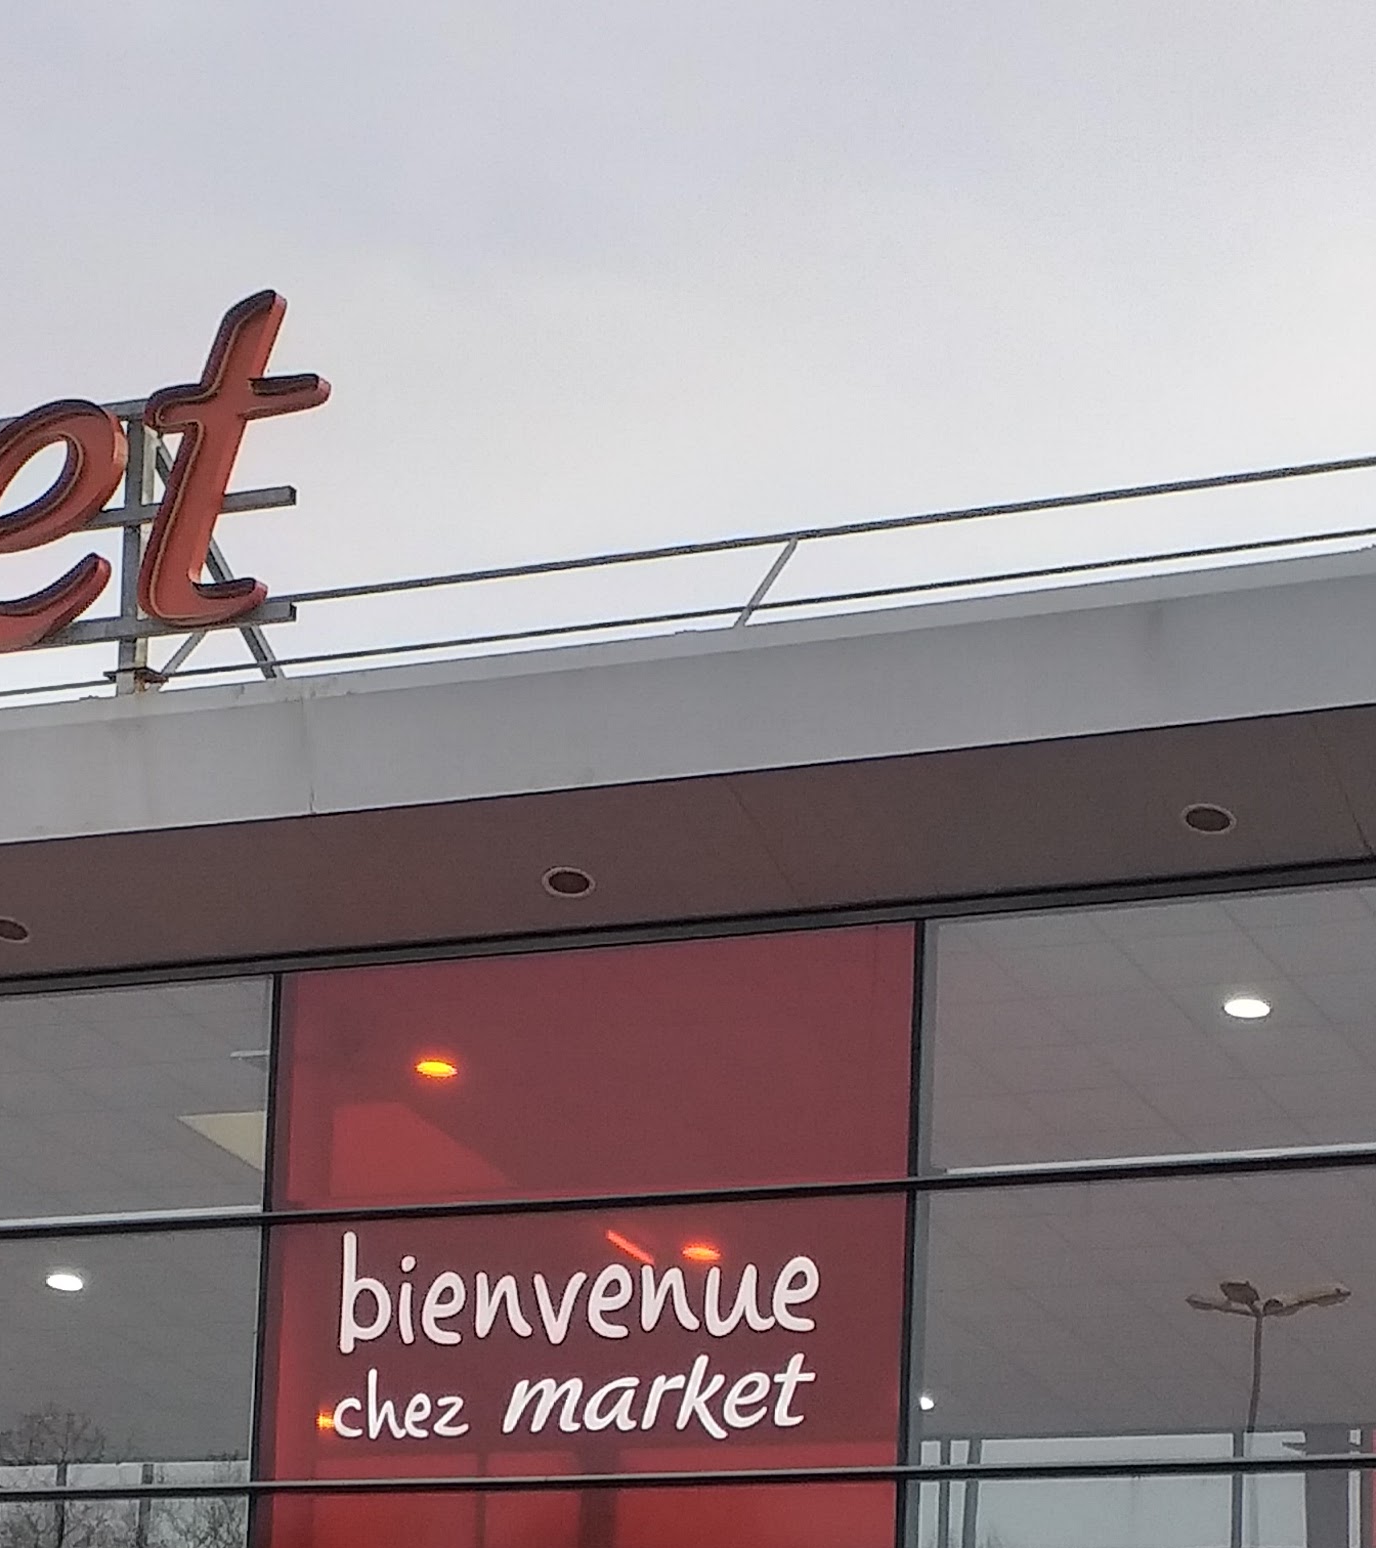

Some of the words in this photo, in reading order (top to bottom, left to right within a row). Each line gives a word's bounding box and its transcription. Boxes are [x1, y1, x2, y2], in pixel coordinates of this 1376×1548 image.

[340, 1230, 820, 1354] bienvenue
[333, 1369, 469, 1440] chez
[502, 1353, 816, 1440] market
